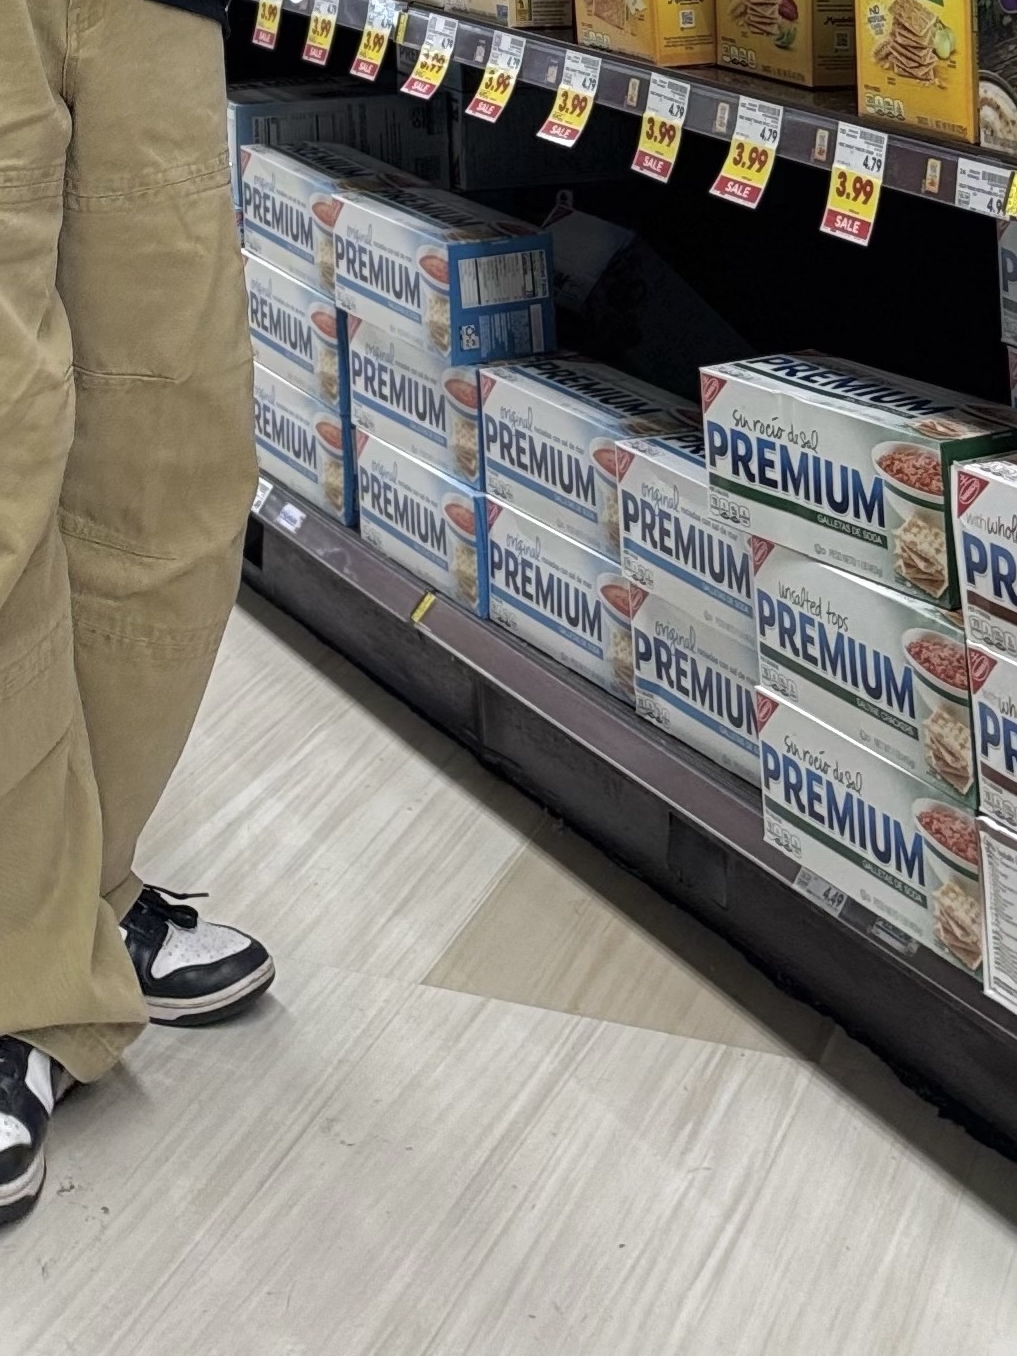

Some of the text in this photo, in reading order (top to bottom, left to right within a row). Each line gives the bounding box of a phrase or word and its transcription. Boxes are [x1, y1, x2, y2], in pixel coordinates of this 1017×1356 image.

[261, 1, 278, 23] 3.99
[259, 32, 271, 43] SALE
[312, 17, 331, 38] 3.99
[363, 31, 384, 53] 3.99
[309, 47, 322, 59] SALE
[358, 62, 373, 74] SALE
[485, 69, 511, 95] 3.99
[412, 79, 428, 93] SALE
[477, 101, 495, 115] SALE
[558, 90, 588, 118] 3.99
[668, 103, 684, 119] 4.79
[550, 123, 571, 138] SALE
[646, 116, 676, 147] 3.99
[759, 127, 778, 144] 4.79
[642, 156, 663, 172] SALE
[732, 142, 769, 174] 3.99
[862, 155, 882, 172] 4.79
[725, 181, 750, 198] SALE
[835, 171, 874, 205] 3.99
[244, 182, 313, 251] PREMIUM
[835, 215, 861, 235] SALE
[335, 233, 421, 308] PREMIUM
[250, 290, 313, 360] REMIUM
[351, 350, 446, 432] PREMIUM
[523, 358, 662, 417] PREMIUM
[748, 356, 955, 416] PREMIUM
[254, 396, 317, 470] REMIUM
[500, 406, 533, 432] original
[787, 424, 798, 445] de
[484, 412, 596, 506] PREMIUM
[707, 420, 885, 528] PREMIUM
[360, 466, 447, 556] PREMIUM
[641, 482, 679, 513] original
[817, 513, 883, 544] GALLETAS DE SODA
[966, 512, 1017, 543] with whol
[506, 533, 541, 563] original
[621, 488, 751, 600] PREMIUM
[490, 539, 602, 642] PREMIUM
[826, 605, 849, 632] tops
[655, 620, 697, 656] original
[757, 587, 915, 720] PREMIUM
[832, 761, 844, 783] de
[761, 739, 926, 887] PREMIUM
[823, 887, 844, 909] 4.49
